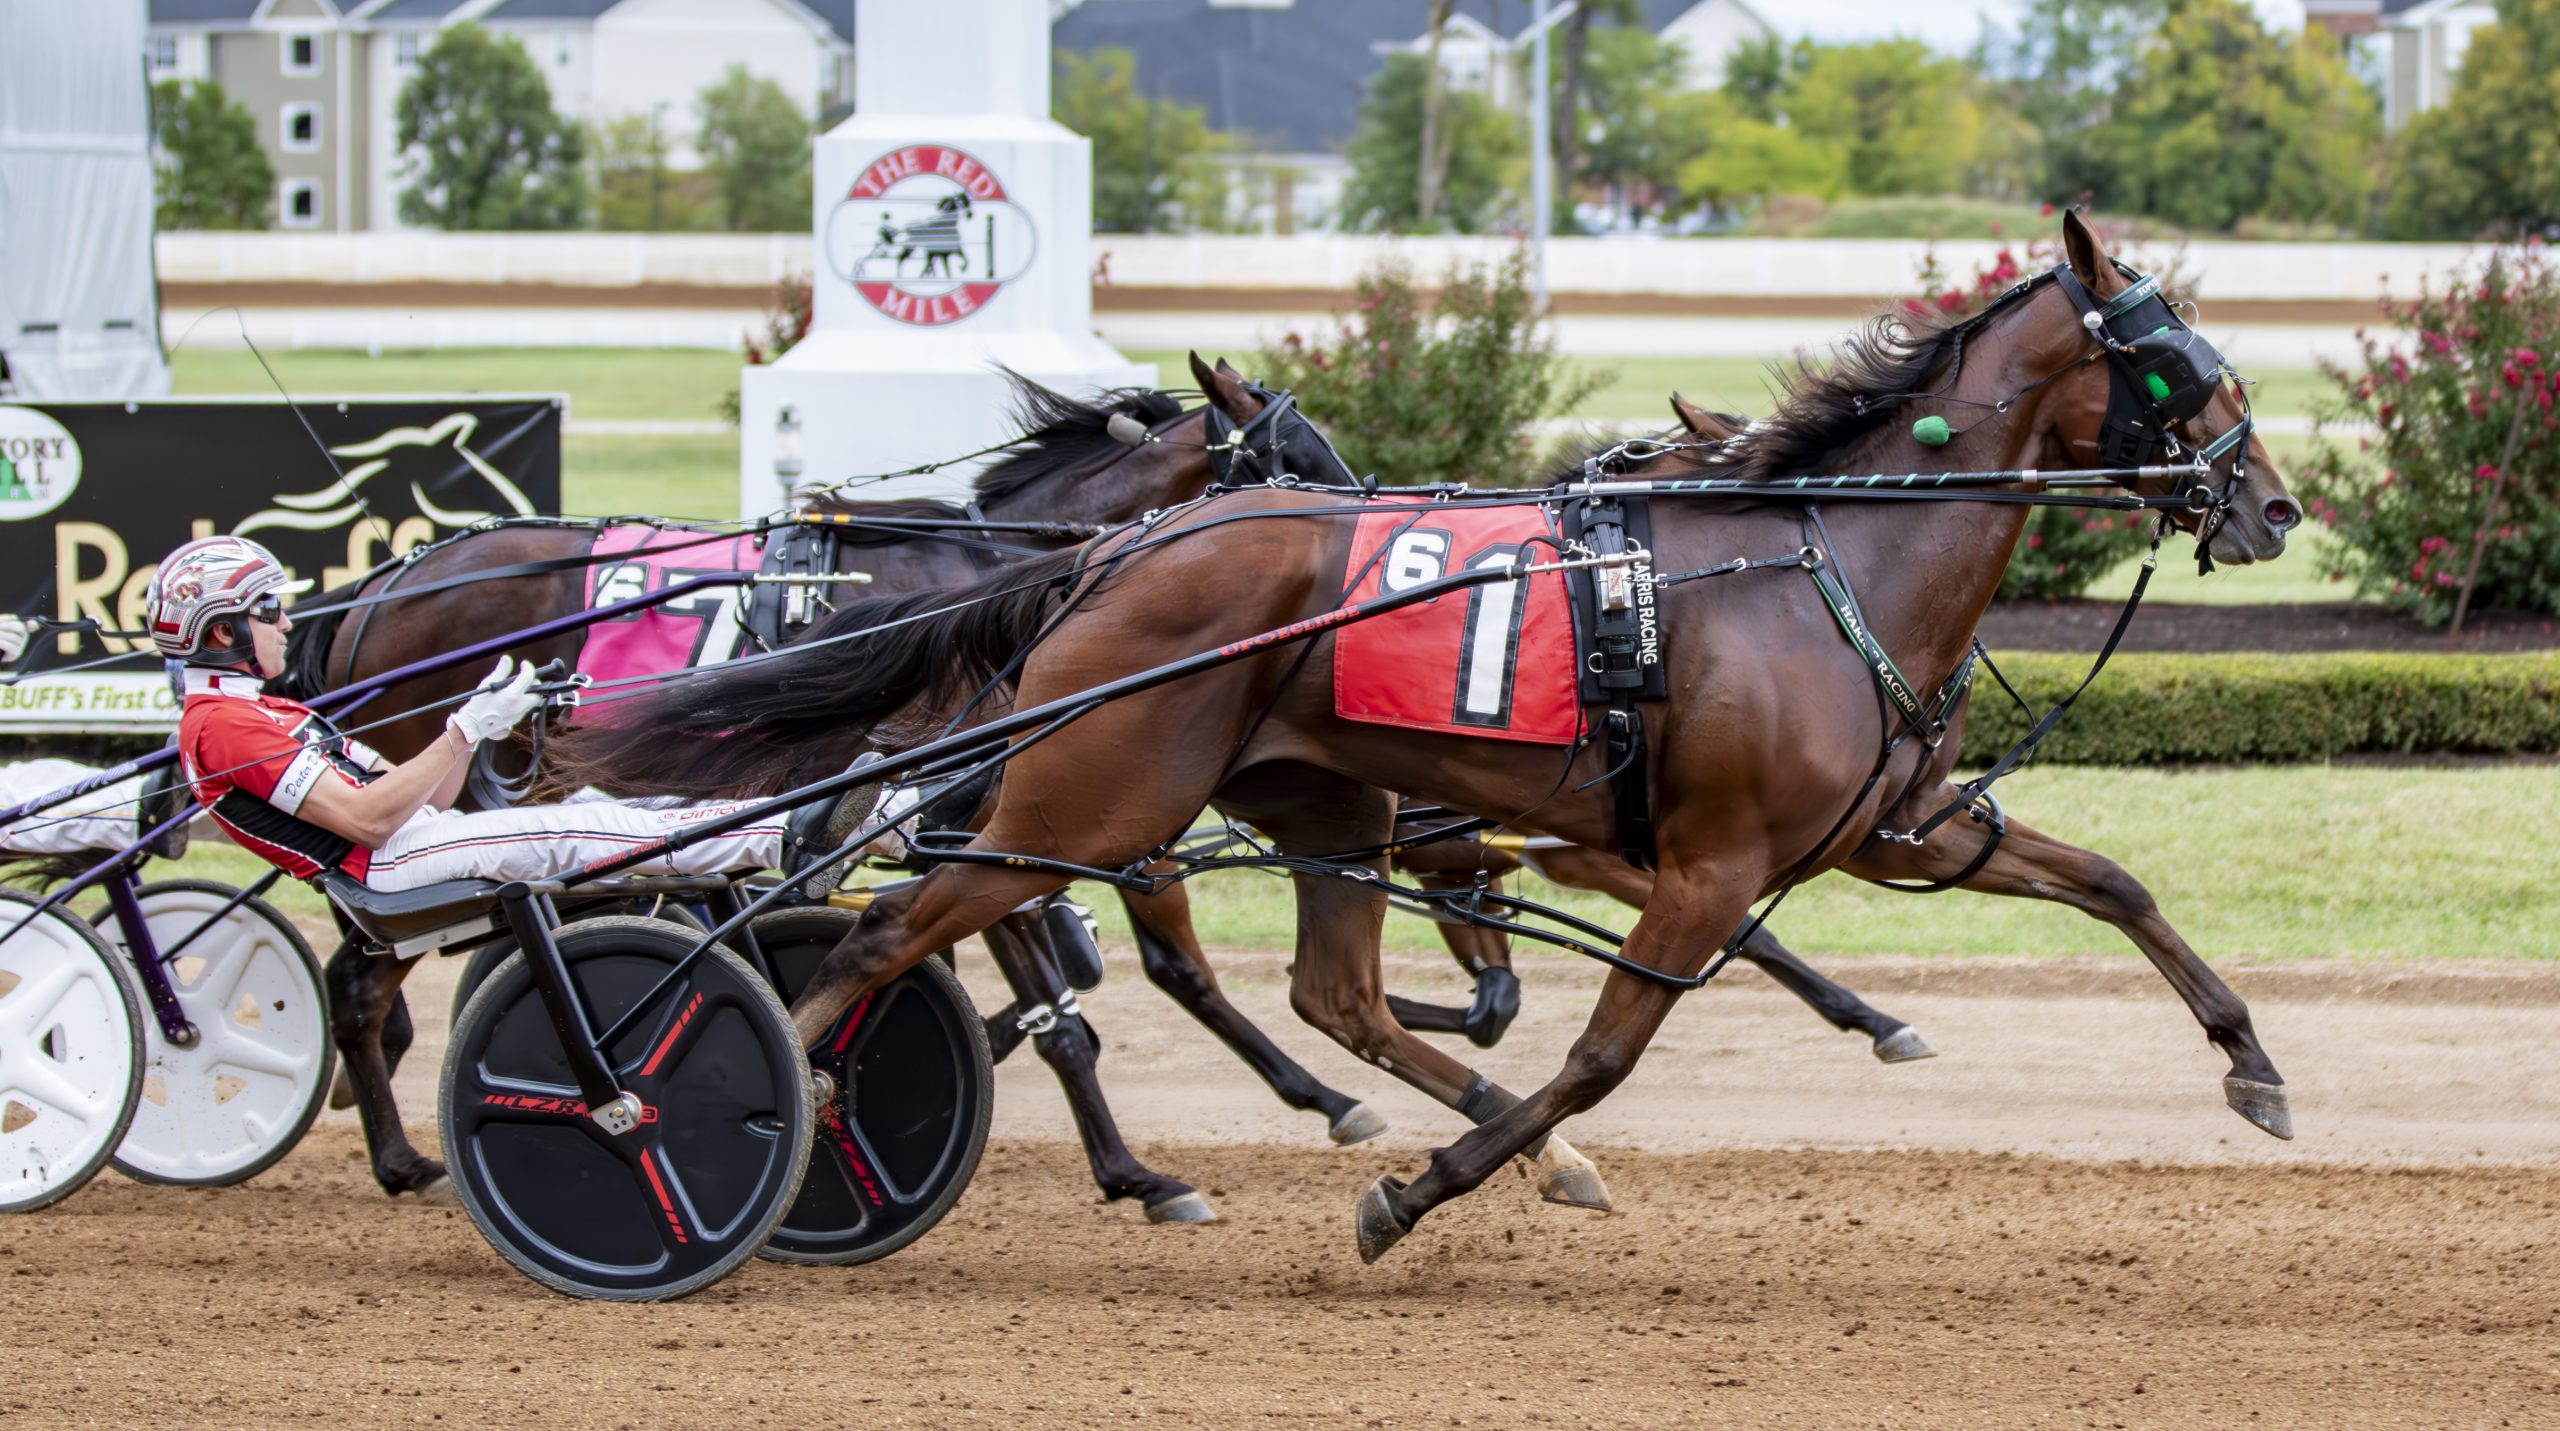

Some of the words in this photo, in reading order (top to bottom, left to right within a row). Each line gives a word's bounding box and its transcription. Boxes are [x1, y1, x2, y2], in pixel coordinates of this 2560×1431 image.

[858, 149, 921, 197] THE
[936, 150, 995, 197] RED
[880, 289, 976, 321] MILE
[1385, 531, 1446, 602] 6
[1634, 561, 1653, 605] ARRIS
[666, 573, 751, 675] 7
[1463, 550, 1521, 717] 1
[1639, 608, 1658, 665] RACING
[0, 687, 82, 709] BUFF's
[91, 687, 146, 709] First
[1877, 661, 1916, 712] RACING
[284, 766, 312, 797] Dexter
[509, 1095, 579, 1114] LZR
